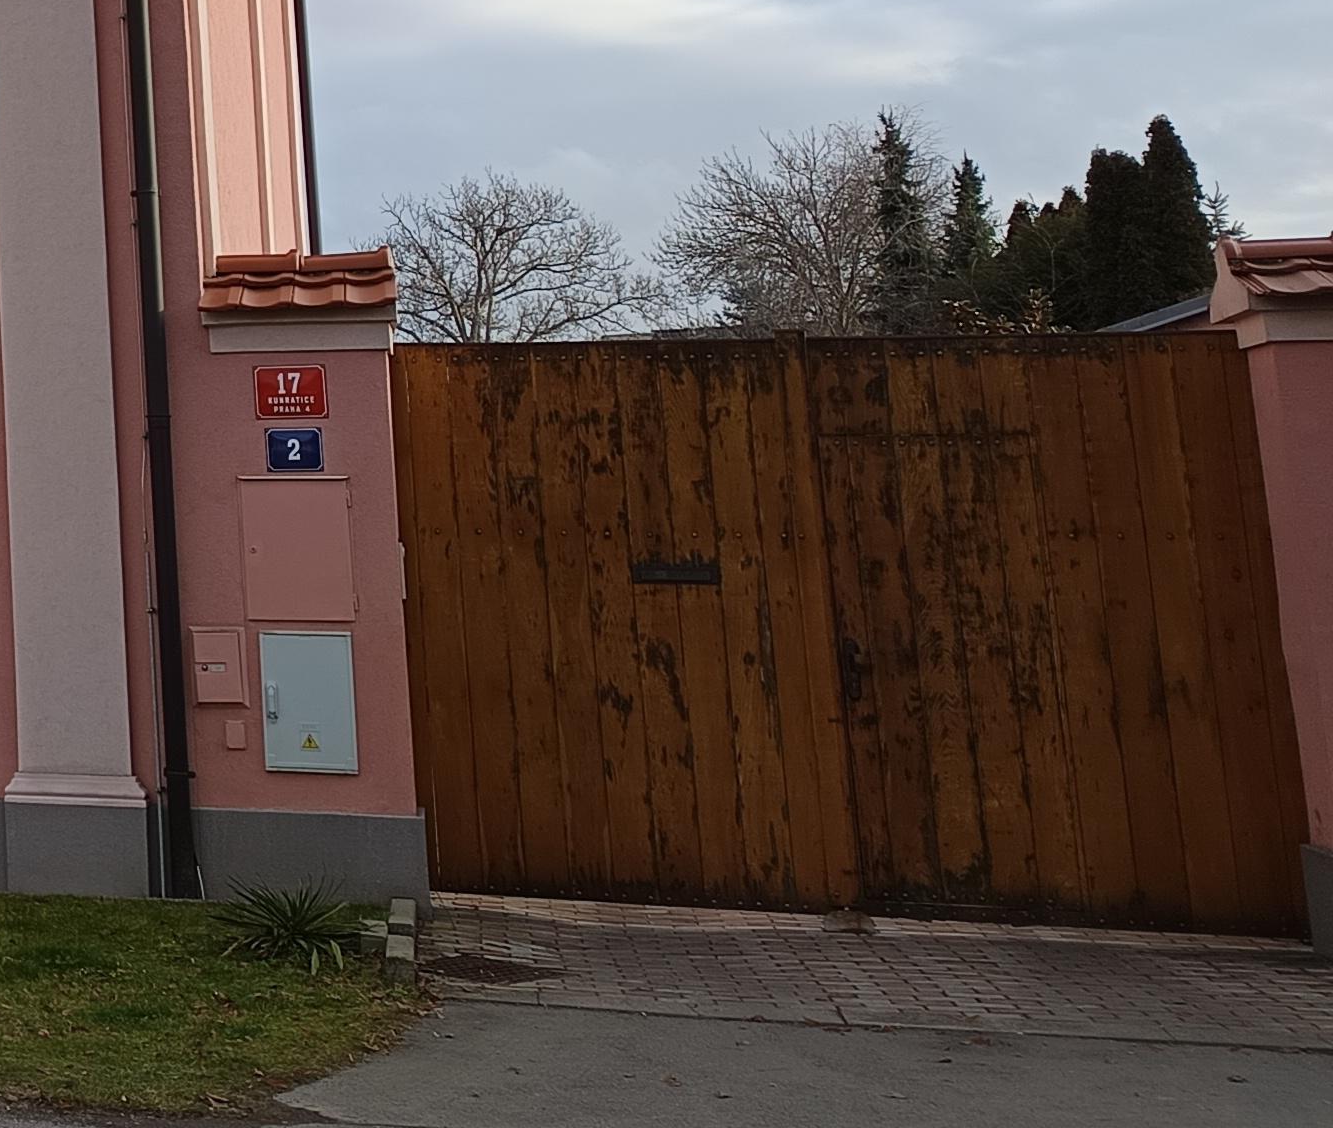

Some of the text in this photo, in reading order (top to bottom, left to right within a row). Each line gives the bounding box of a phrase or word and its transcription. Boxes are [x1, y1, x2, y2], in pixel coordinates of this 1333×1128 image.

[277, 372, 301, 394] 17
[268, 396, 315, 404] KUNRATICE
[287, 438, 301, 461] 2
